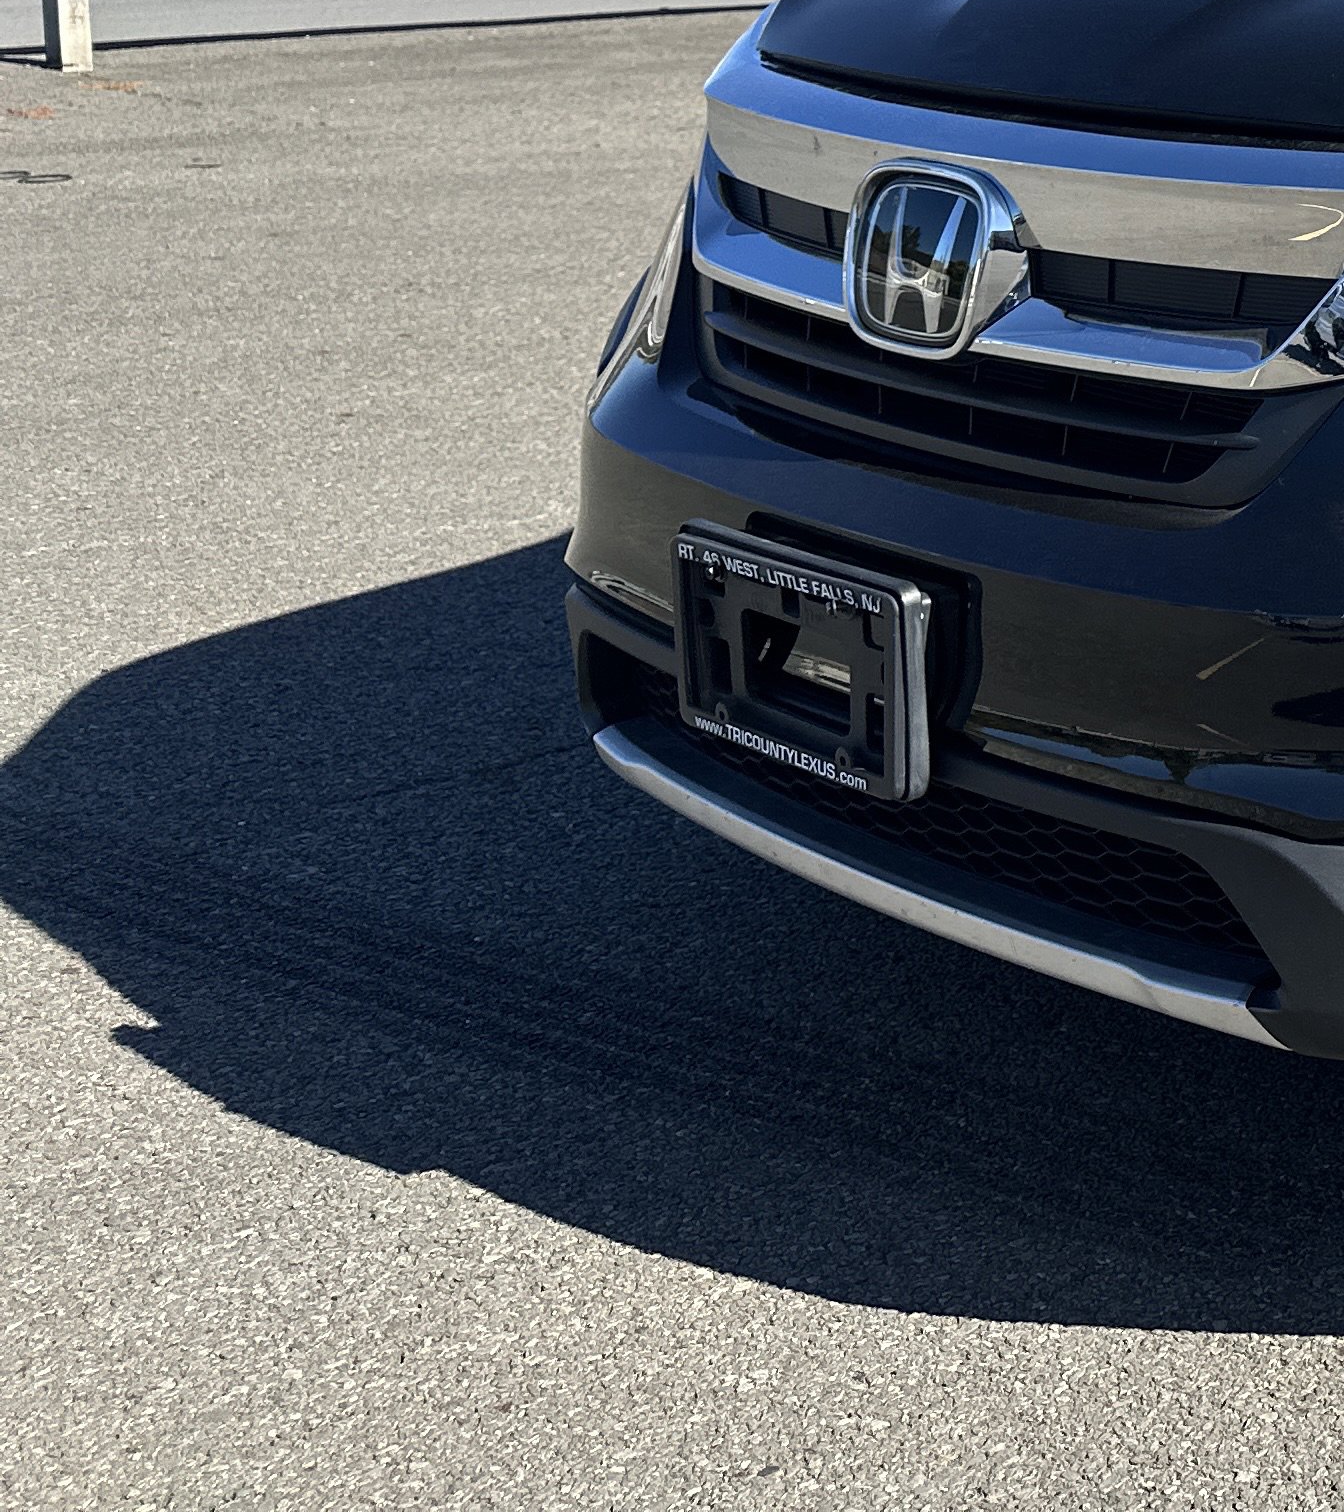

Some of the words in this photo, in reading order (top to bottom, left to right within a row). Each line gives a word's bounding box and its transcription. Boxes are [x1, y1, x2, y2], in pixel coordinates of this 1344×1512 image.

[678, 543, 700, 562] RT.
[766, 568, 810, 594] LITTLE
[861, 593, 881, 613] NJ
[694, 715, 868, 791] www.TRICOUNTYLEXUS.com
